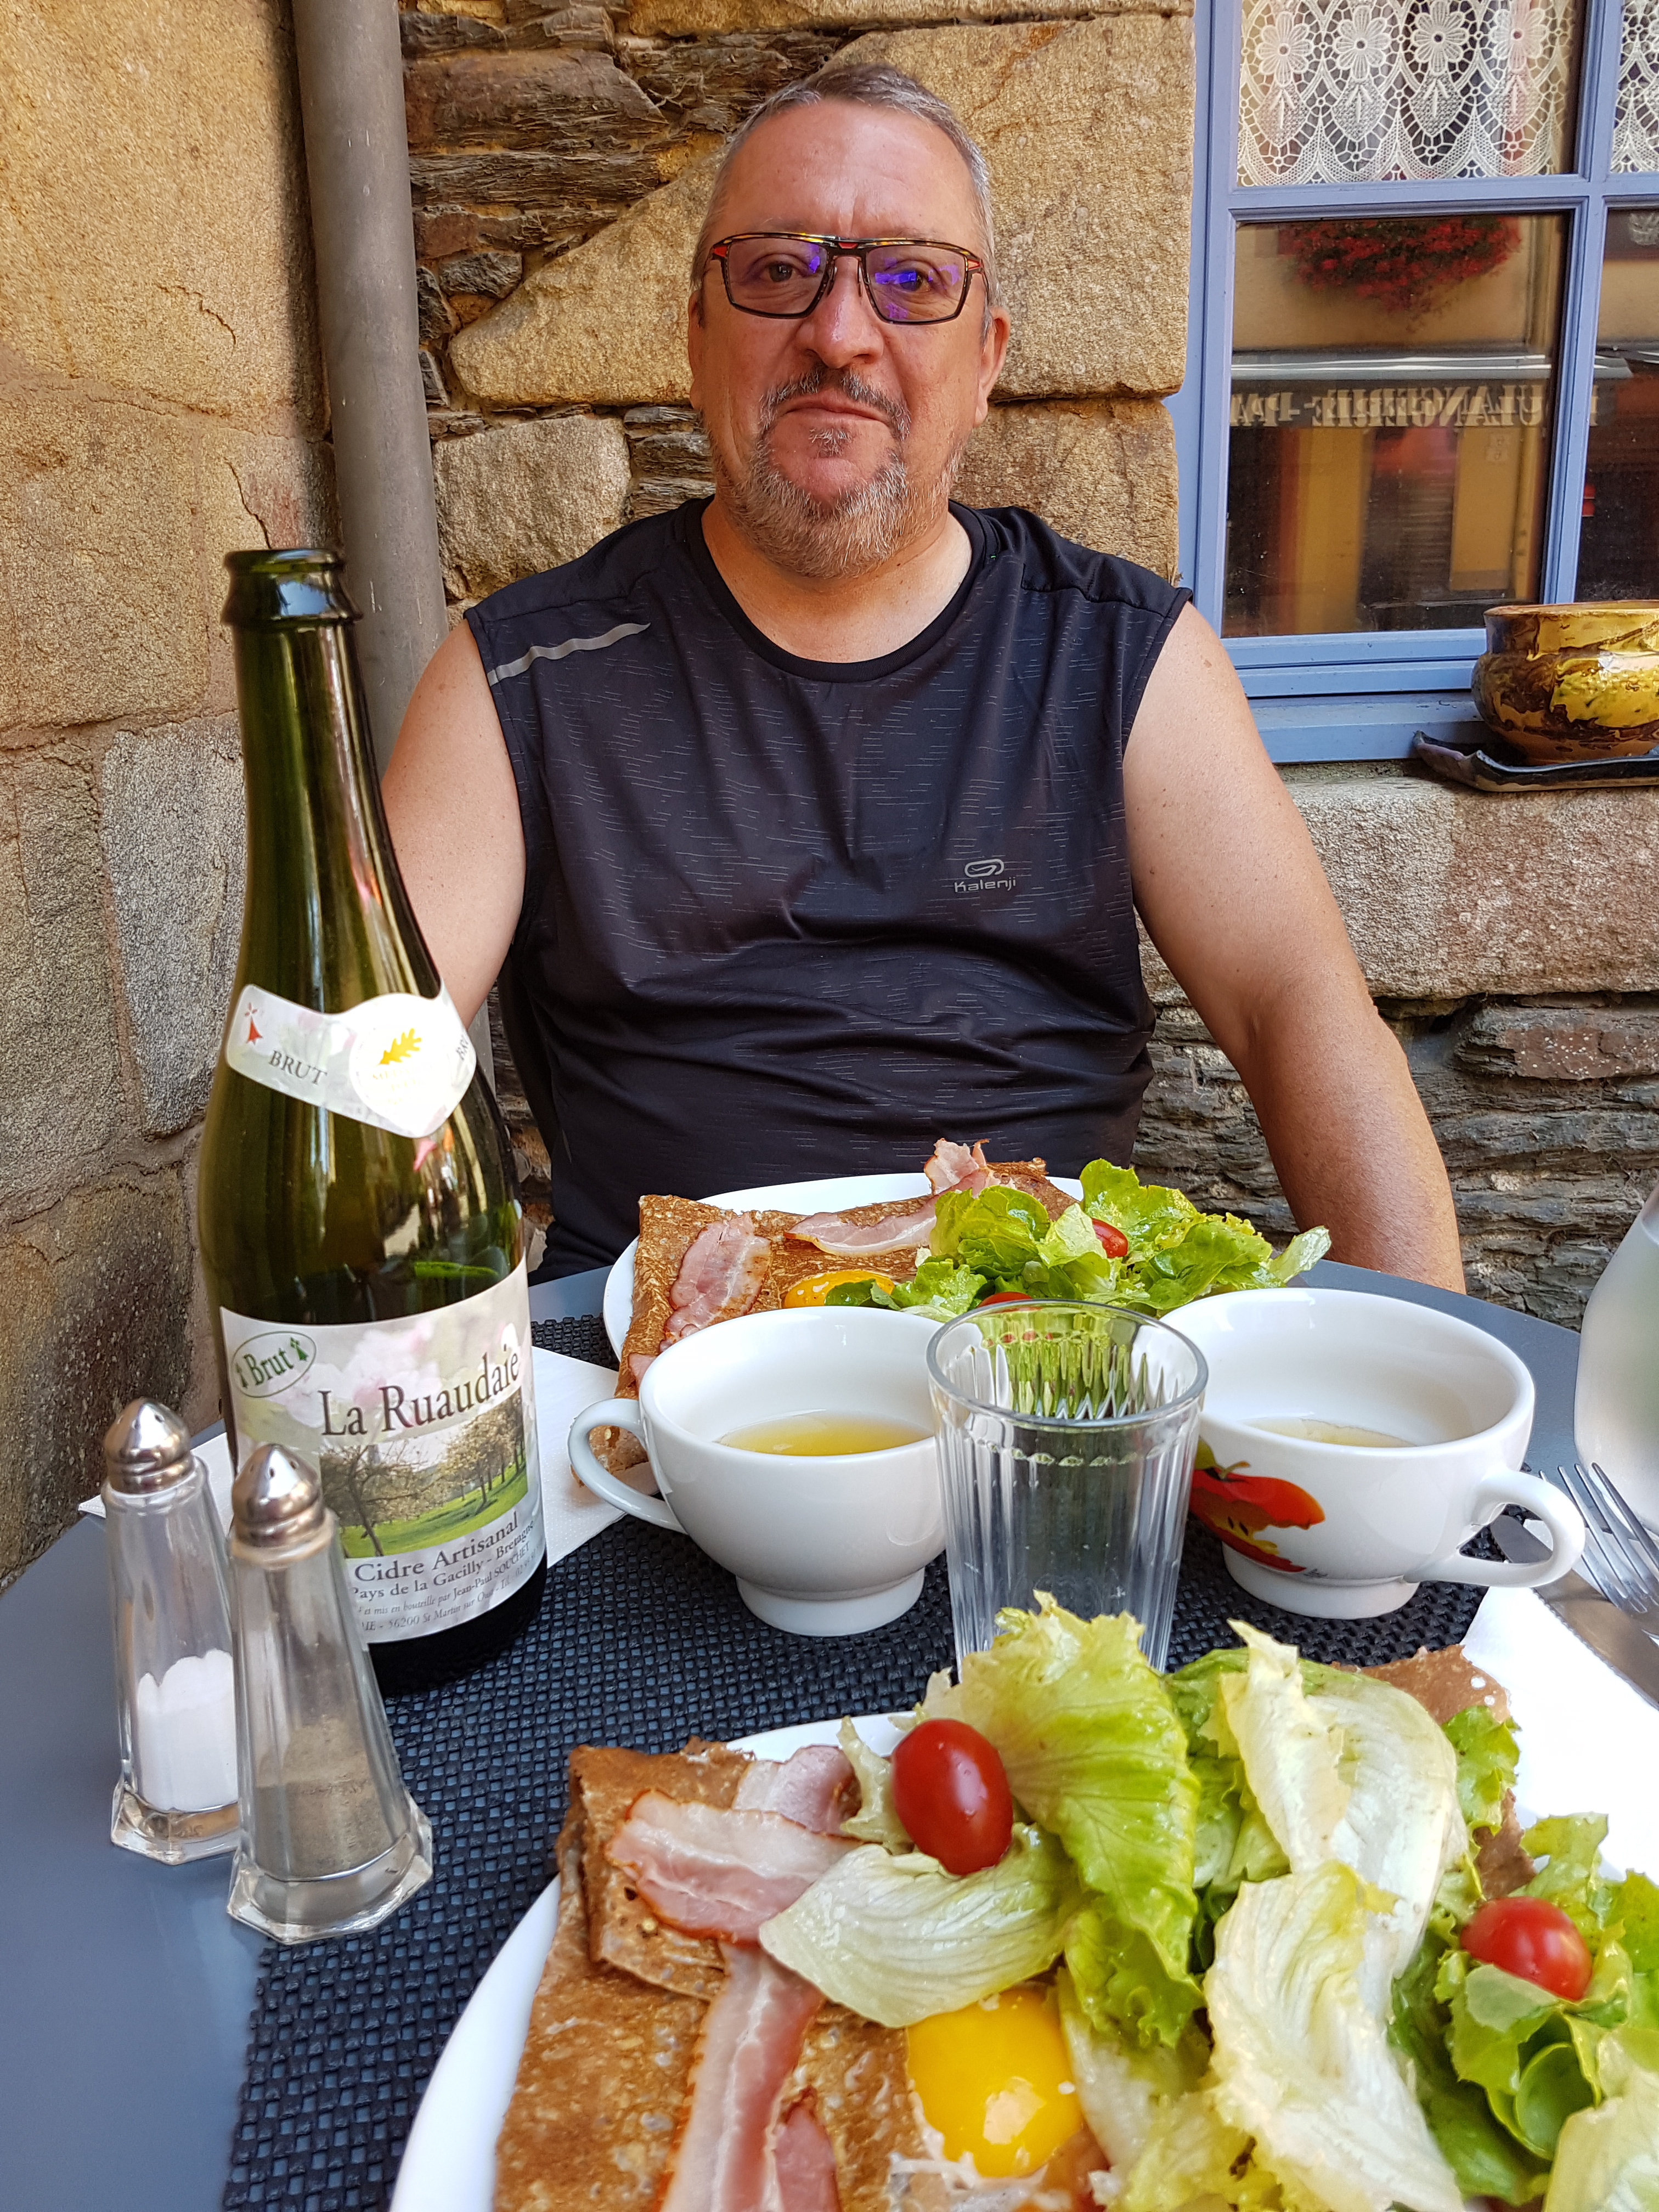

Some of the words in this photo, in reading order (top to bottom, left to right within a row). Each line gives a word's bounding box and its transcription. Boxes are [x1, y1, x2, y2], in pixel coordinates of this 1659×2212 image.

[954, 877, 1016, 893] Kalenji
[268, 1049, 328, 1085] BRUT
[244, 1348, 294, 1386] Brut
[318, 1389, 368, 1436] La
[379, 1344, 518, 1432] Ruaudaie
[354, 1560, 425, 1582] Cidre
[432, 1511, 518, 1570] Artisanal
[390, 1583, 409, 1596] de
[414, 1579, 428, 1592] la
[433, 1559, 484, 1586] Gacilly
[496, 1521, 534, 1560] Bretagne
[374, 1606, 388, 1615] mis
[403, 1594, 436, 1611] bouteille
[453, 1571, 492, 1601] Jean-Paul
[388, 1615, 419, 1629] 56200
[433, 1605, 461, 1621] Martin
